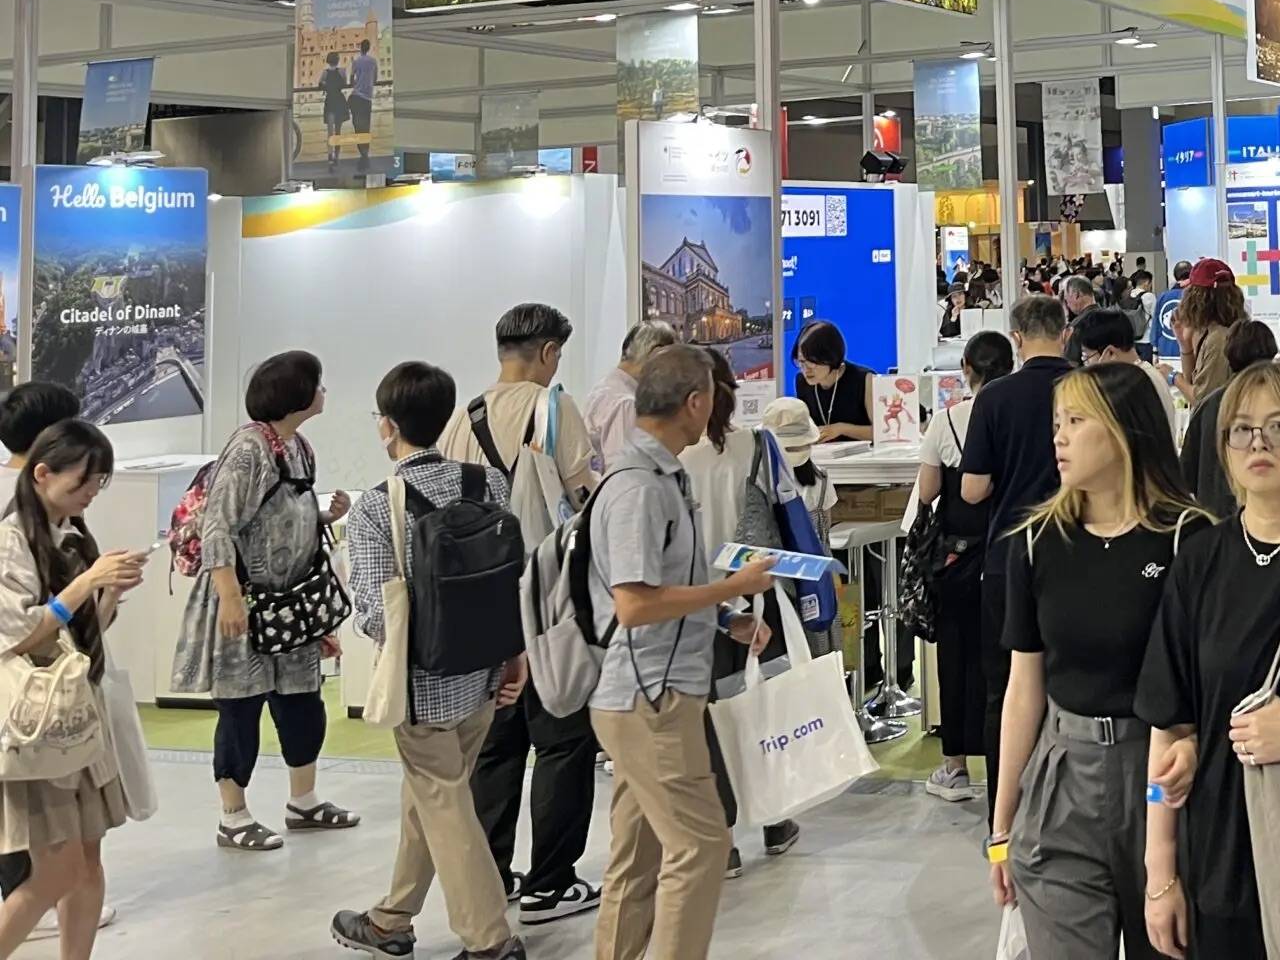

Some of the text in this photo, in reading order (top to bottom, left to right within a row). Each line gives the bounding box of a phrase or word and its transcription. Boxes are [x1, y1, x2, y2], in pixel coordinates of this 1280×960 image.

[50, 183, 195, 213] Hello Belgium
[60, 304, 181, 324] Citadel of Dinant
[759, 716, 824, 755] Trip.com
